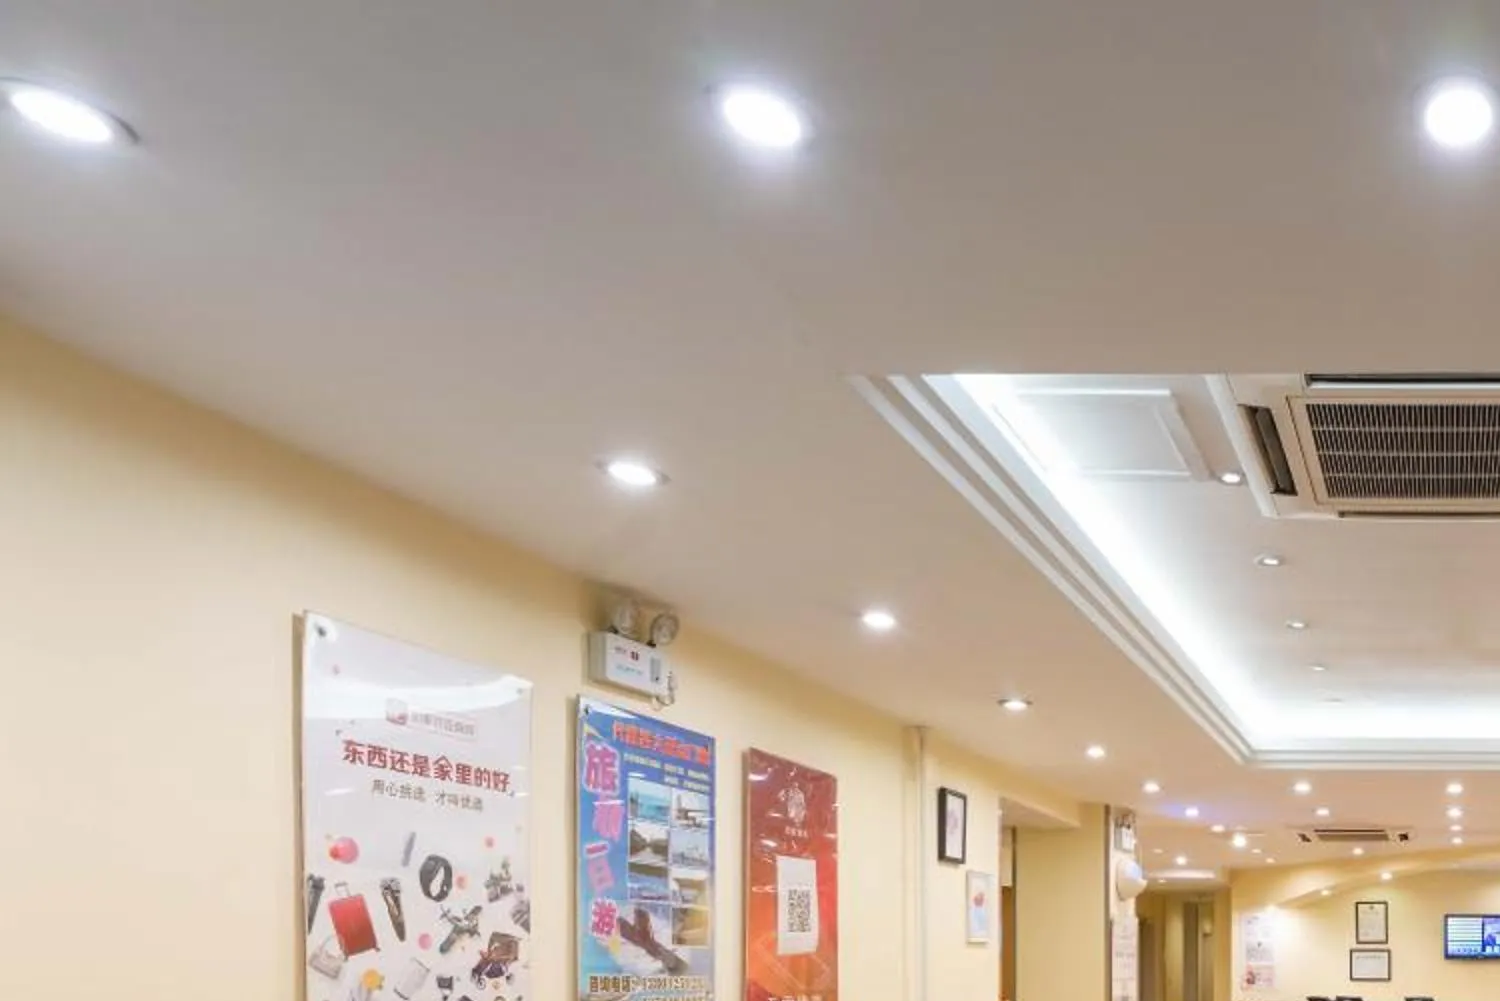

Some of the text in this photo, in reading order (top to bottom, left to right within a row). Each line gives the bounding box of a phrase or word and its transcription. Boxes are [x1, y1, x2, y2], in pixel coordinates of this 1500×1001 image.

[342, 739, 510, 794] 东西还是家里的好
